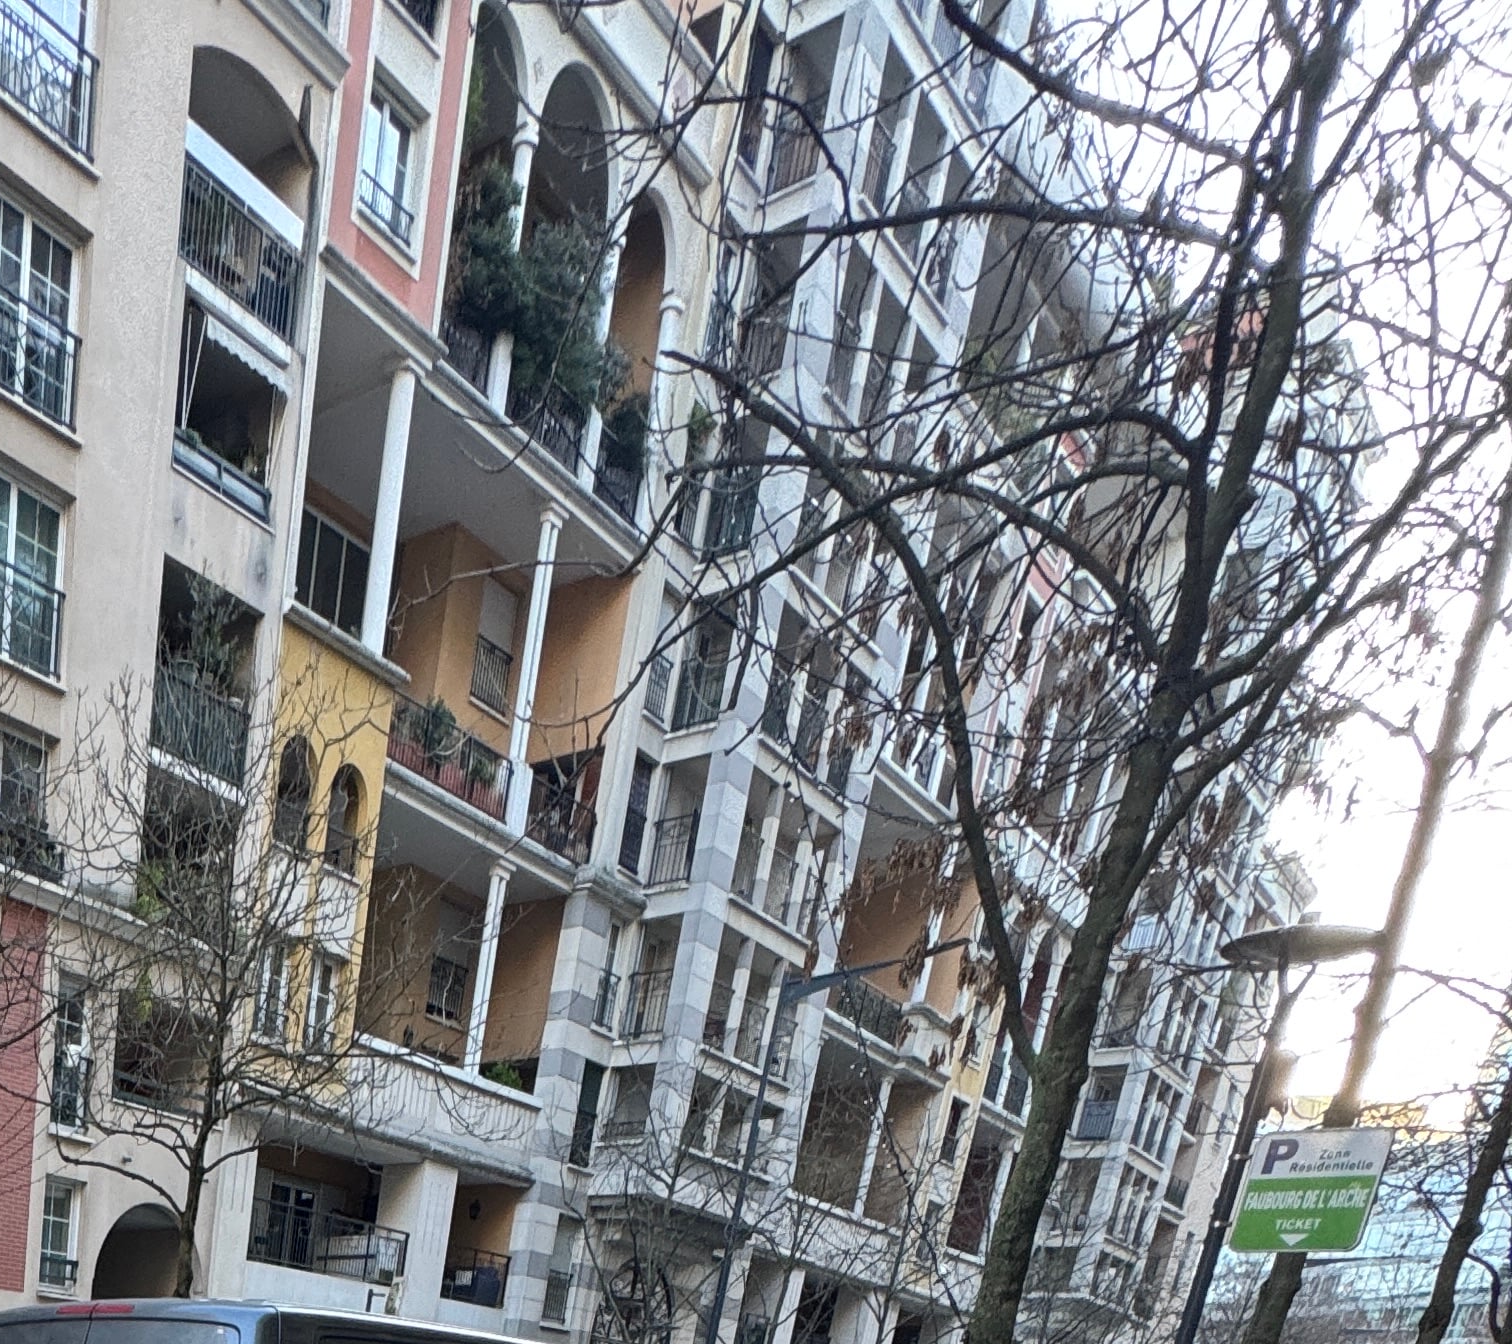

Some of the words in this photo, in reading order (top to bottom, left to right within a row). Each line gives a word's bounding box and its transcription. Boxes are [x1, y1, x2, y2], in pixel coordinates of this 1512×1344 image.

[1261, 1138, 1299, 1175] P
[1319, 1149, 1352, 1160] Zone
[1289, 1160, 1374, 1174] Résidentielle
[1244, 1190, 1304, 1211] FAUBOURG
[1301, 1189, 1320, 1209] DE
[1317, 1187, 1370, 1209] L'ARCHE
[1275, 1218, 1322, 1231] TICKET
